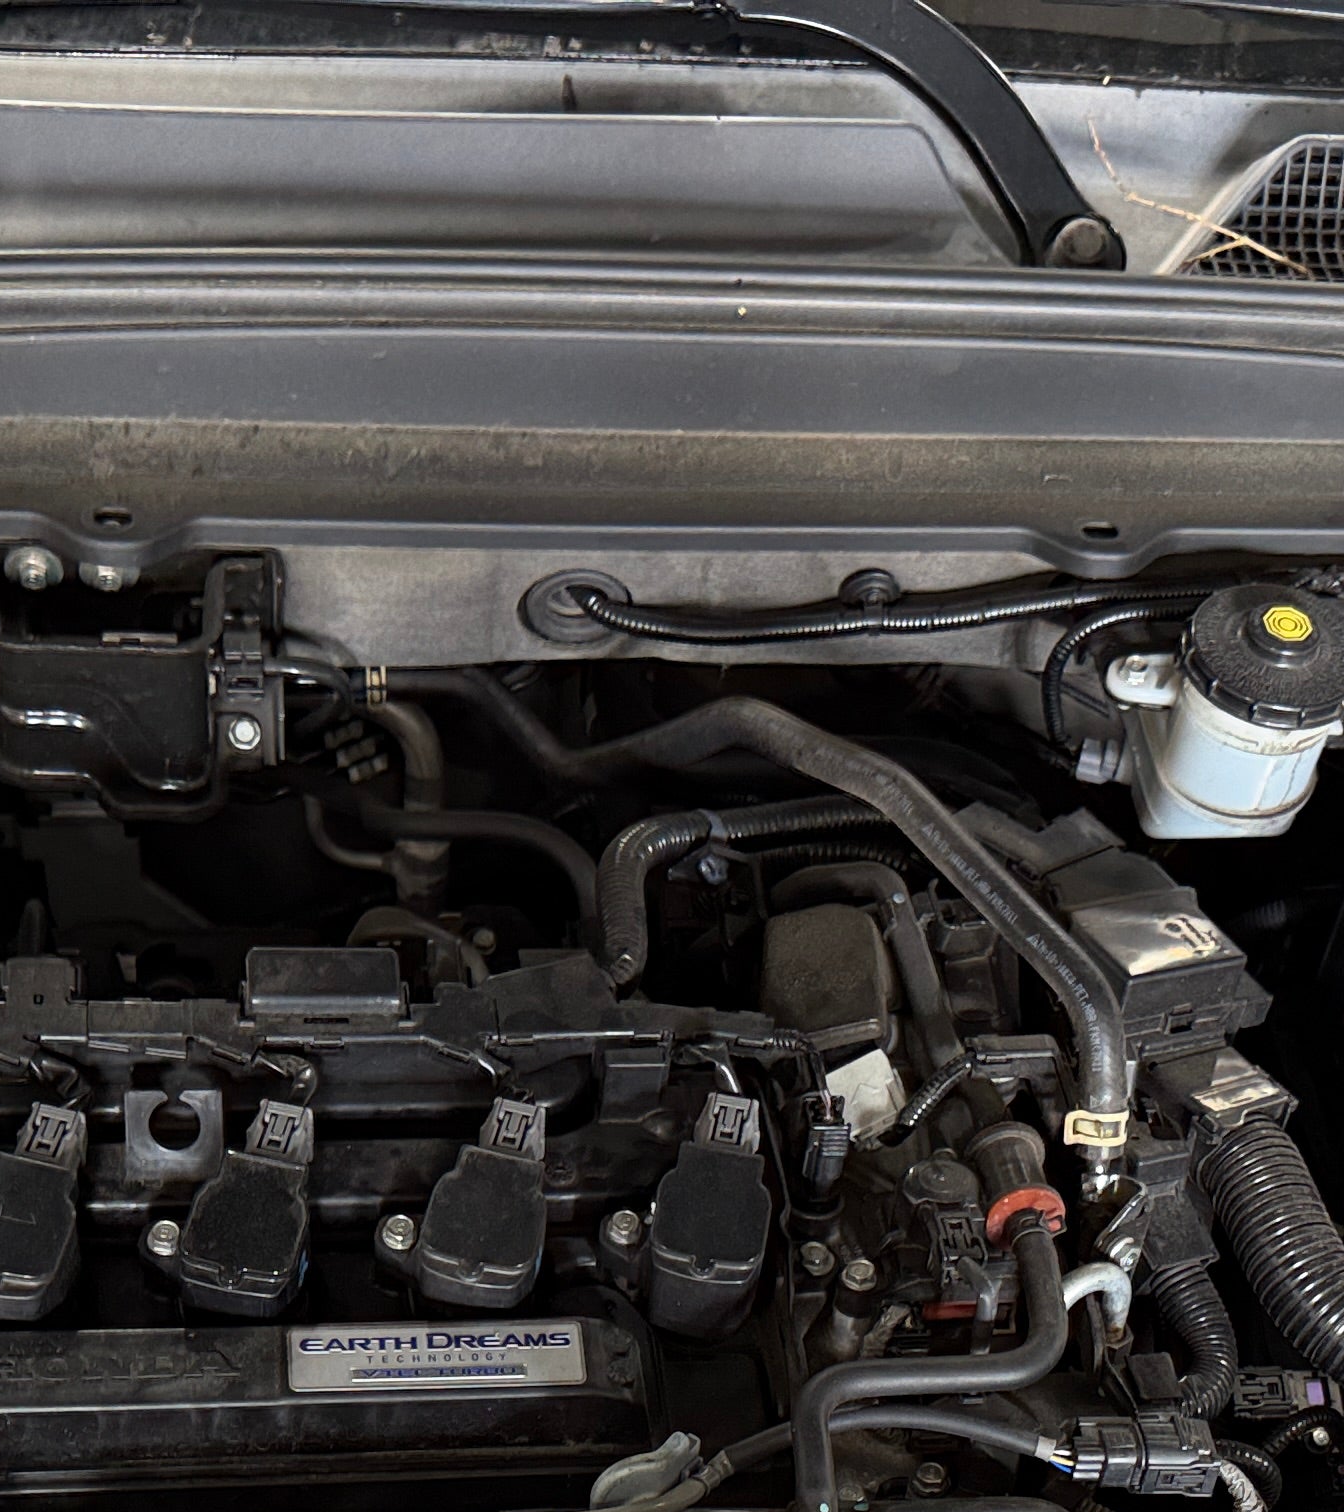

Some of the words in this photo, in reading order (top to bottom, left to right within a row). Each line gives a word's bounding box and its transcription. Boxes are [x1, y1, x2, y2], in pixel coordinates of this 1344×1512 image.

[300, 1336, 417, 1352] EARTH
[427, 1332, 570, 1349] DREAMS
[367, 1352, 507, 1364] TECHNOLOGY
